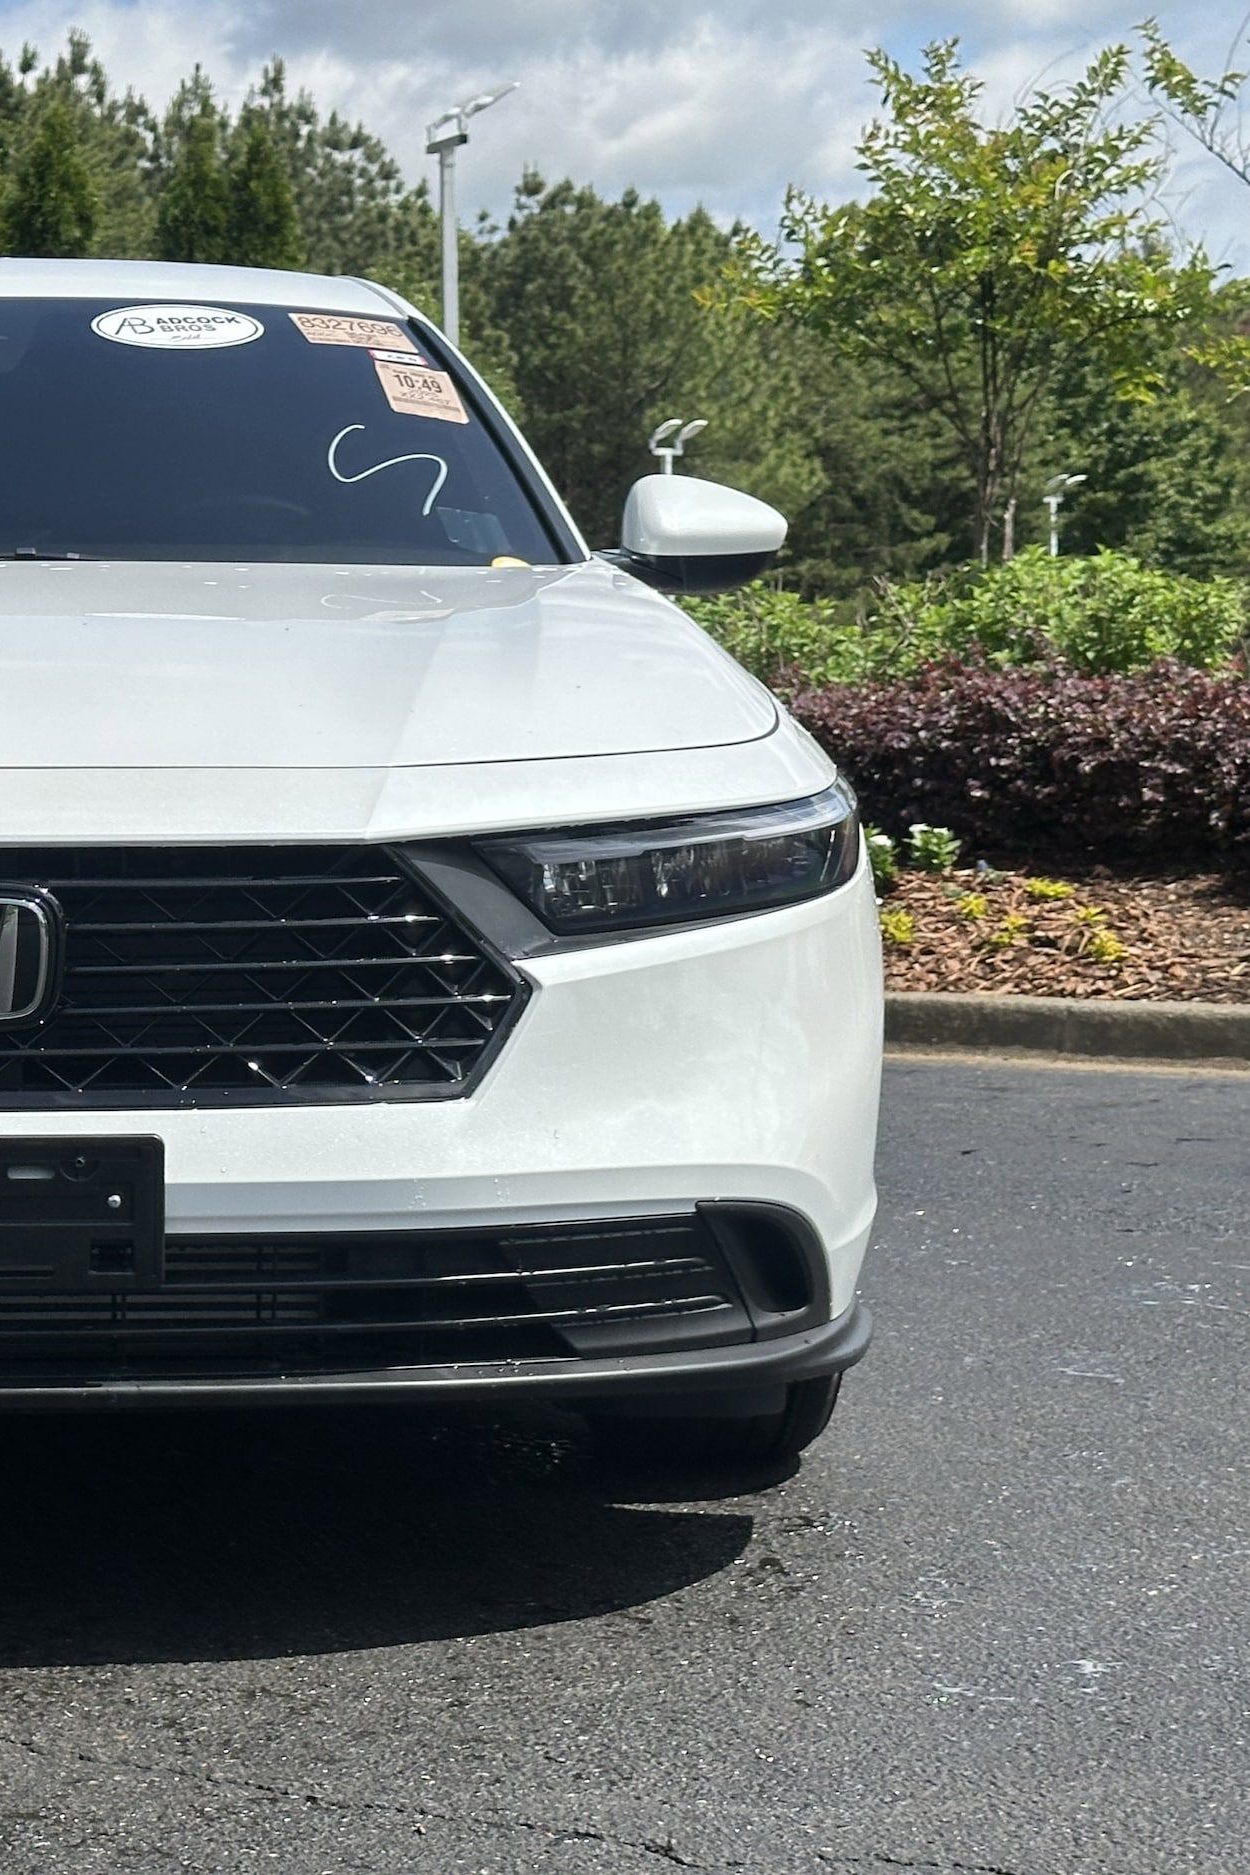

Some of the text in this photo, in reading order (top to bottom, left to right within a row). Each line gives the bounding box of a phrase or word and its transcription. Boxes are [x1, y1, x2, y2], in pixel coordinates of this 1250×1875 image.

[156, 316, 240, 325] ADCOCK
[297, 316, 403, 337] 8327696
[159, 324, 217, 332] BROS
[394, 374, 442, 393] 10:49
